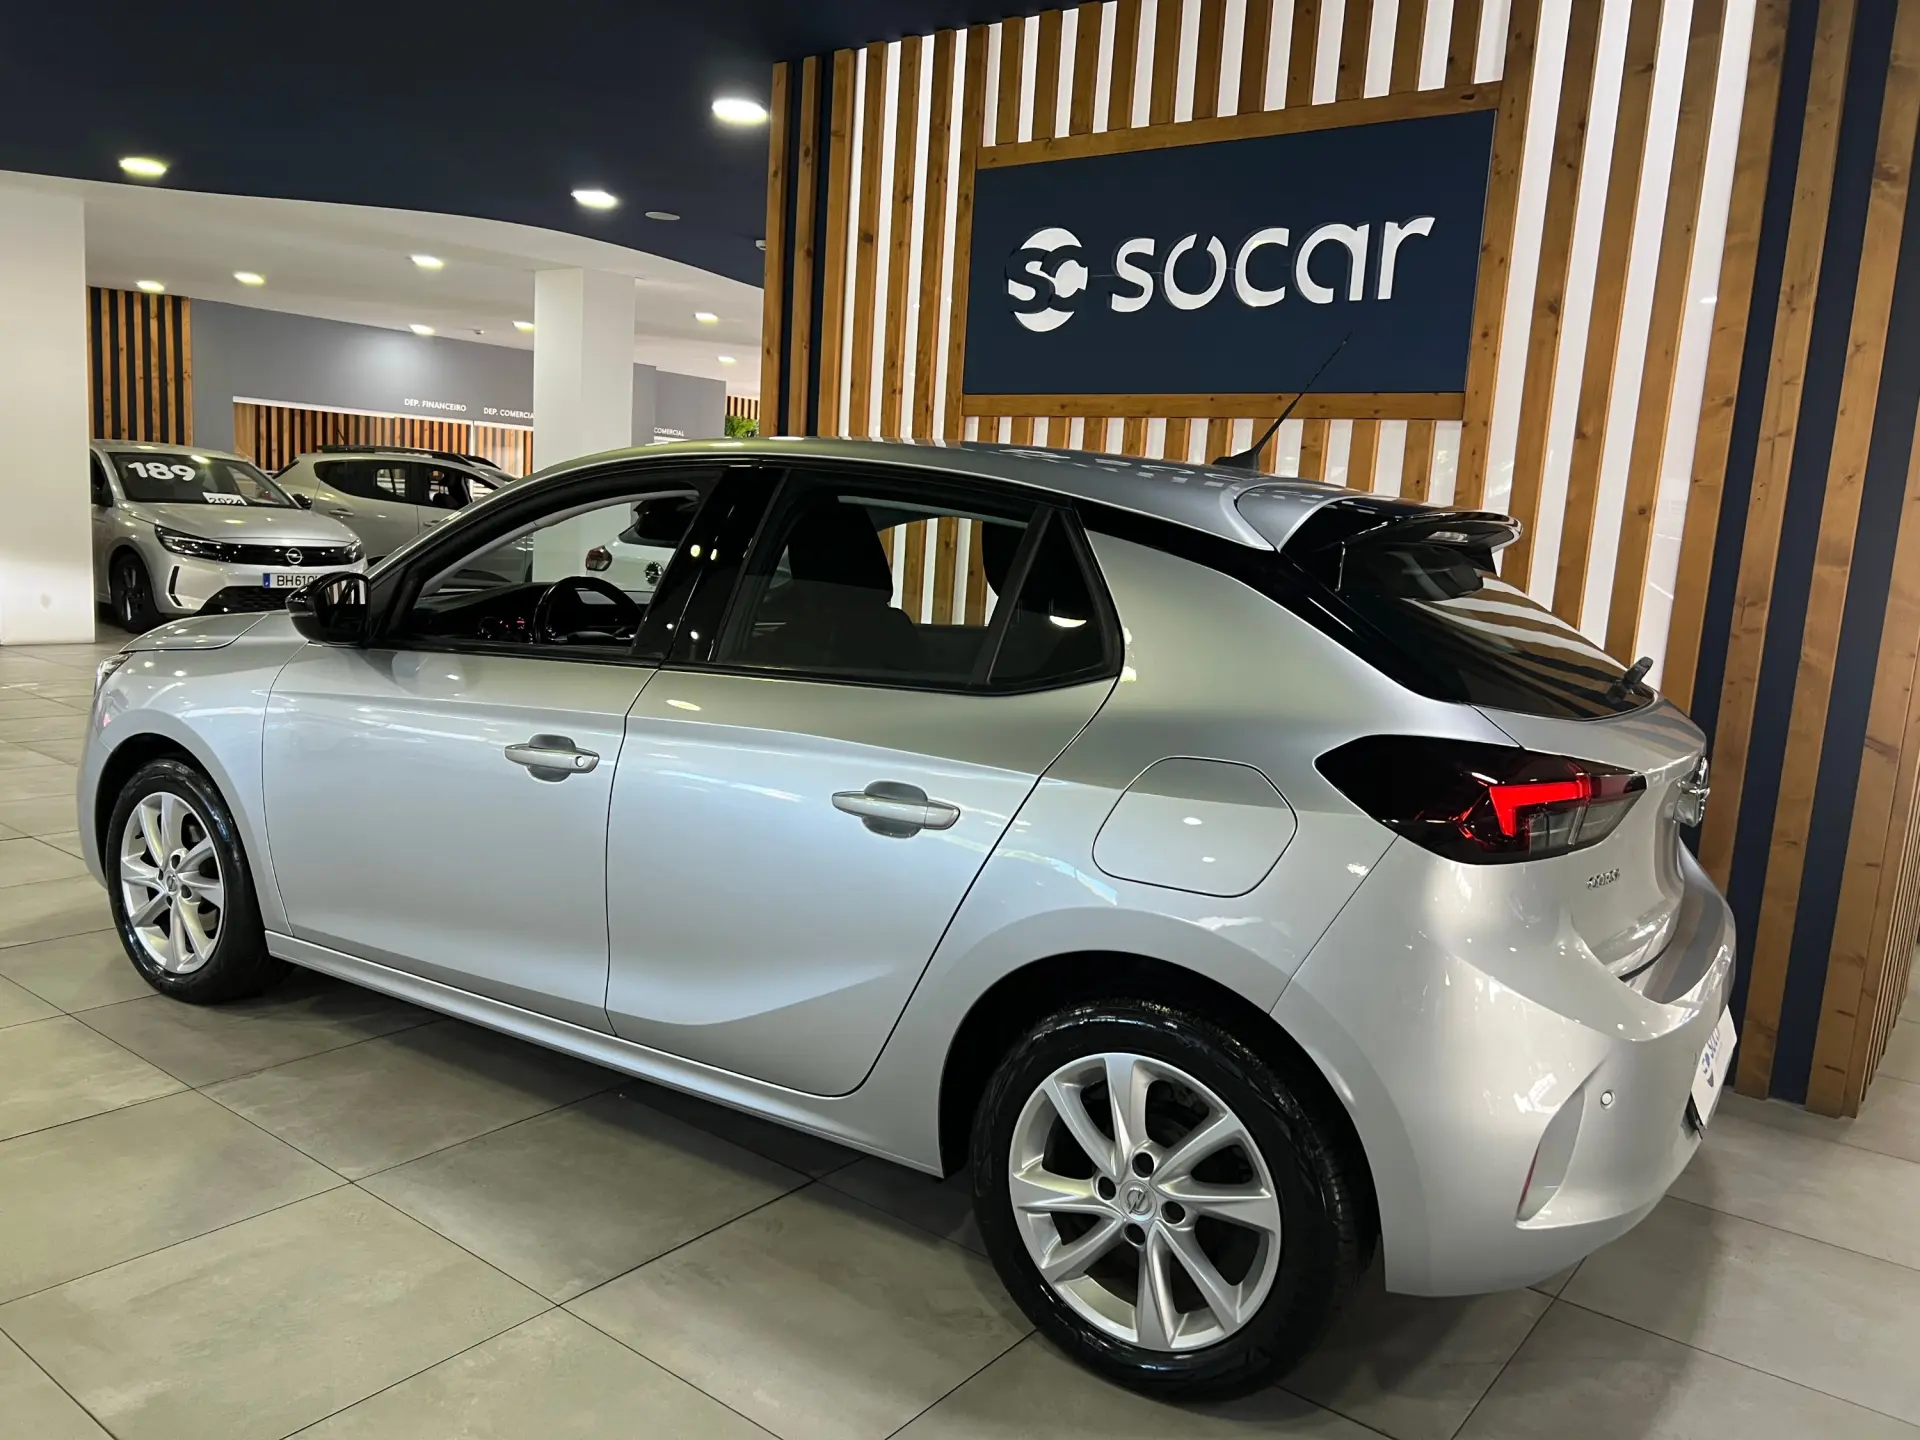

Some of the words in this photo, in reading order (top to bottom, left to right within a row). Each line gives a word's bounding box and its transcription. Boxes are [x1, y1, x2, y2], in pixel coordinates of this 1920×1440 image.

[1111, 216, 1436, 313] socar
[404, 398, 420, 408] DEP.
[422, 400, 467, 412] FINANCEIRO
[483, 407, 499, 416] DEP.
[500, 409, 534, 419] COMERCIA
[653, 427, 685, 437] COMERCIAL
[128, 461, 196, 482] 189
